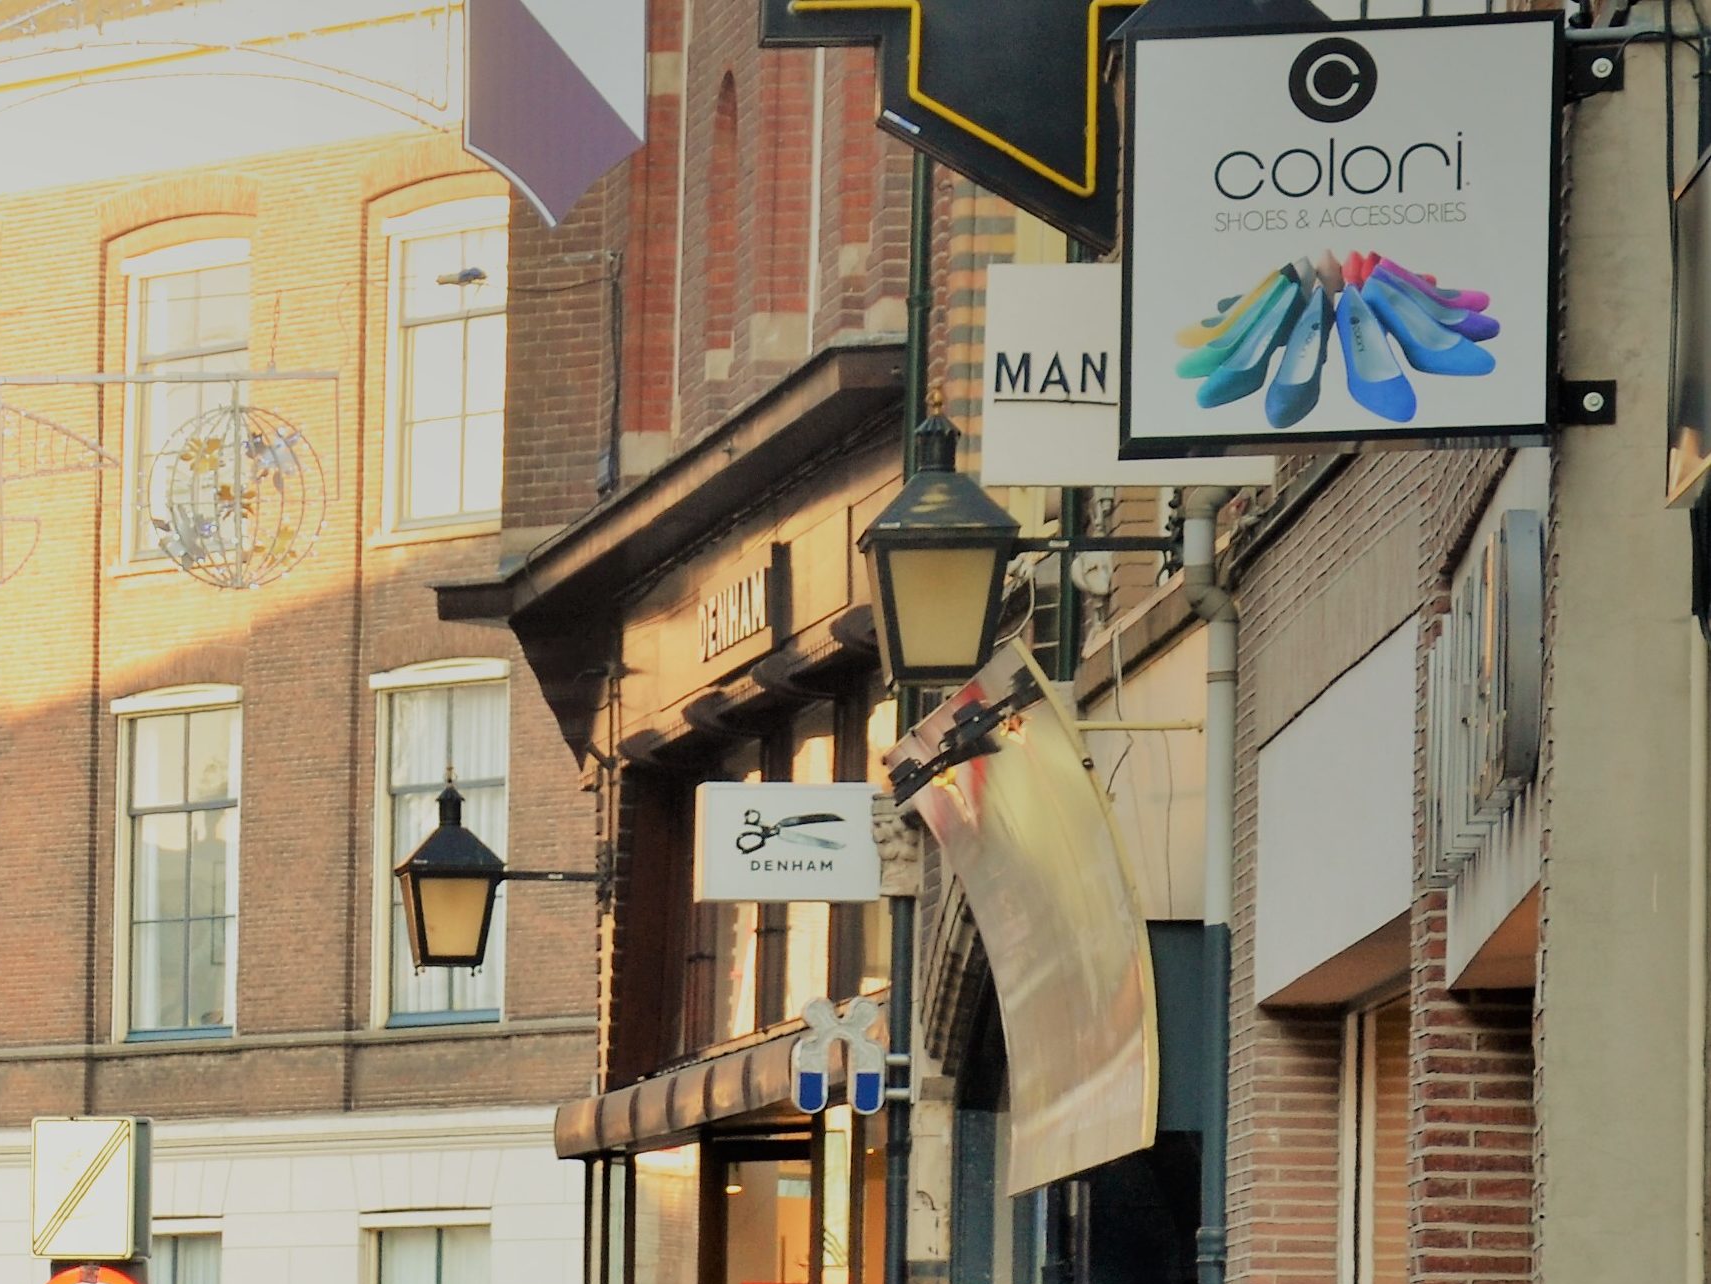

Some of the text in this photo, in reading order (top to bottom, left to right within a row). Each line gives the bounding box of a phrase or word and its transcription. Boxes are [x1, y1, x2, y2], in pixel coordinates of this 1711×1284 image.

[1214, 131, 1463, 200] colori
[1214, 201, 1467, 232] SHOES & ACCESSORIES
[994, 351, 1108, 394] MAN
[697, 566, 766, 663] DENHAM
[750, 860, 833, 872] DENHAM
